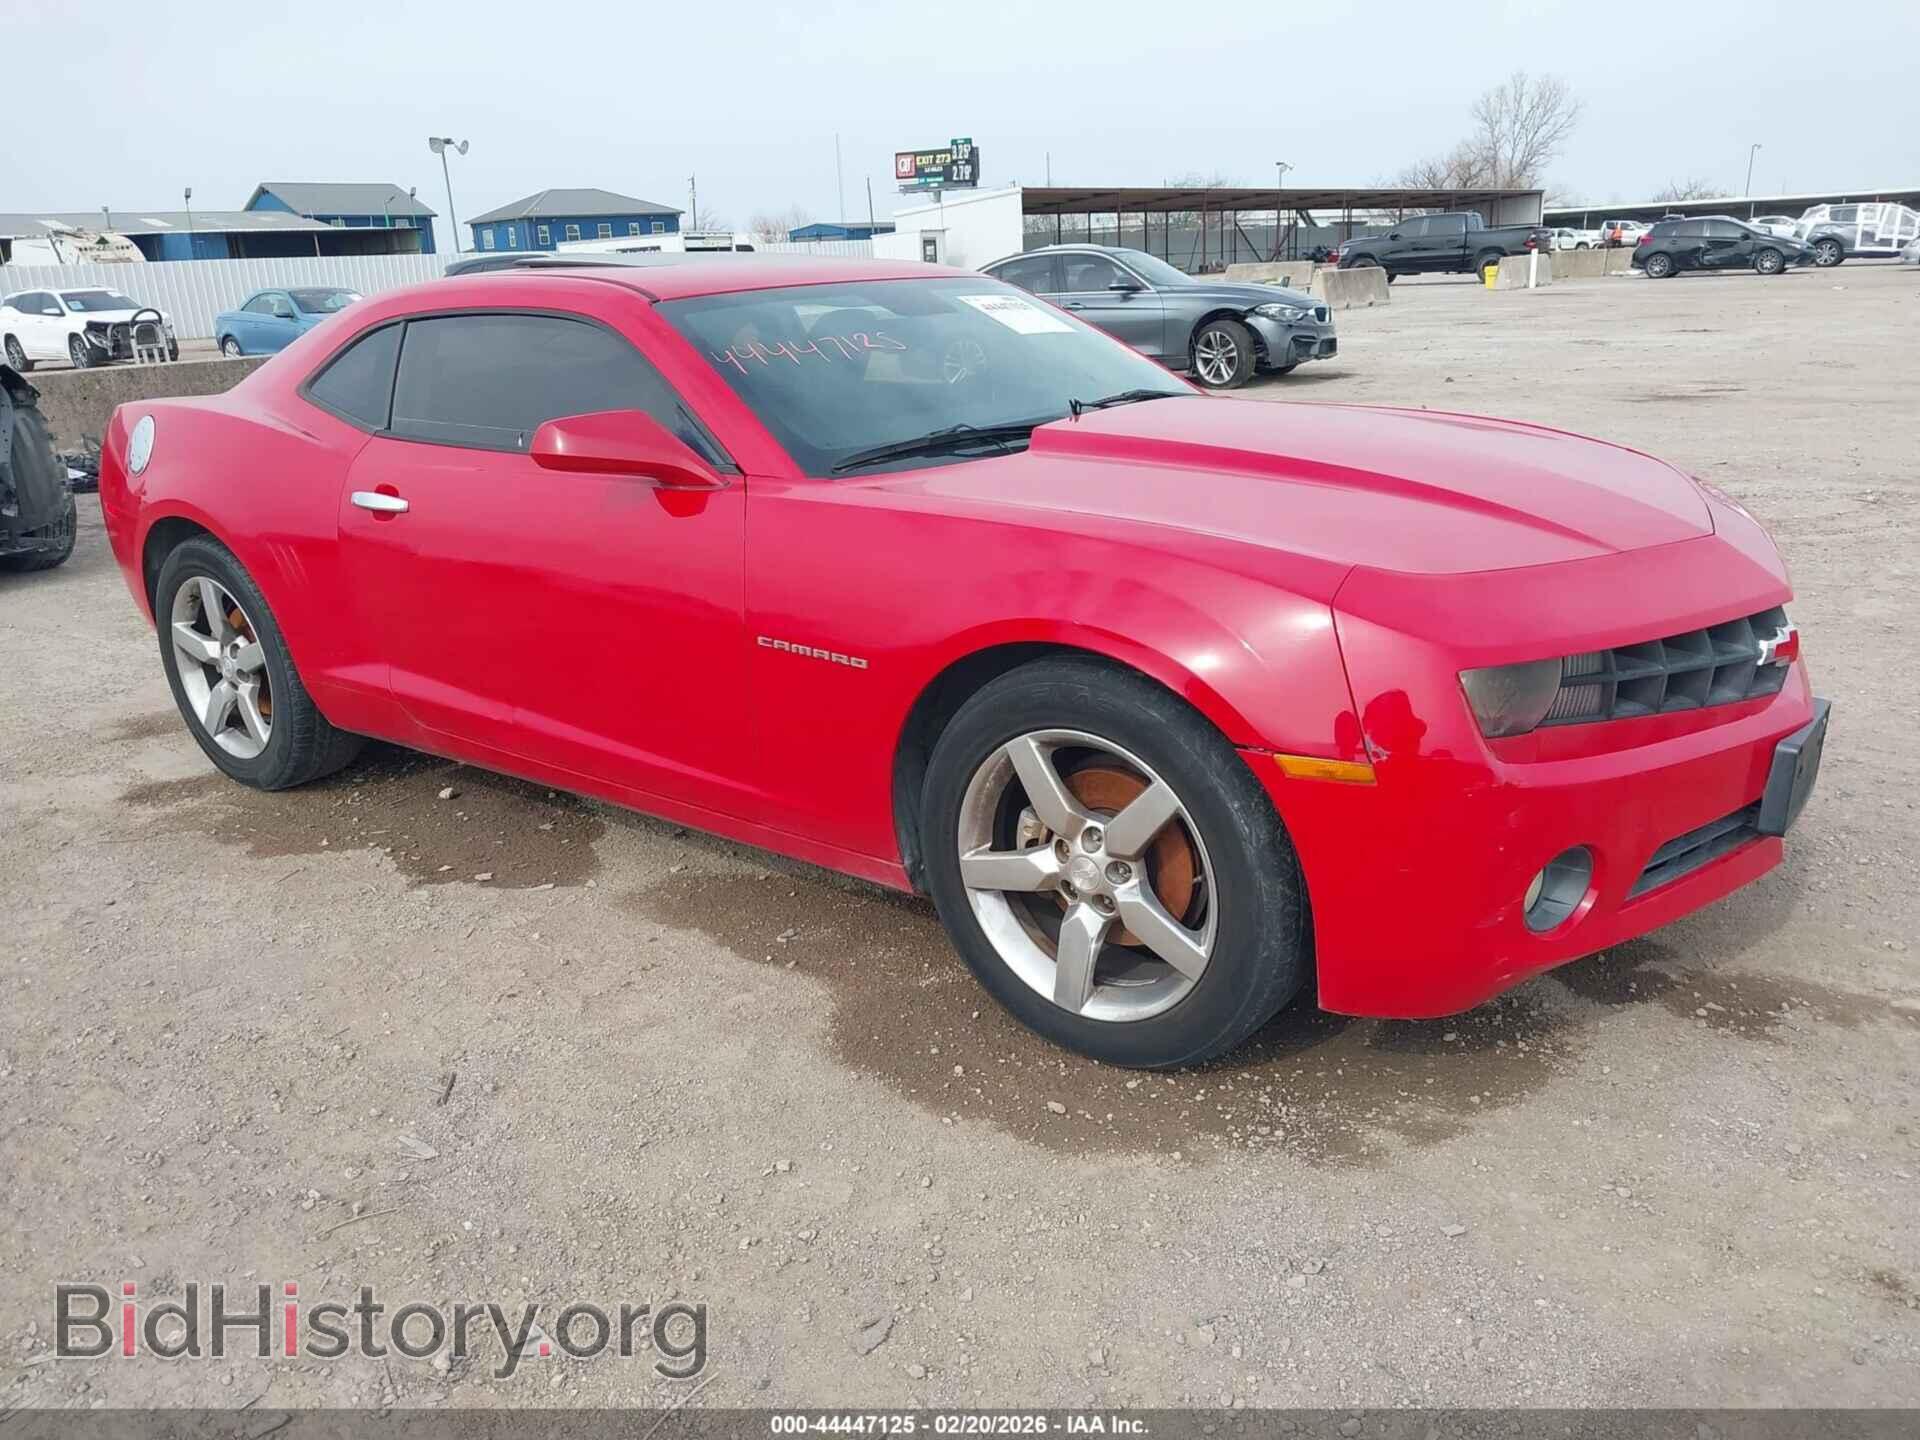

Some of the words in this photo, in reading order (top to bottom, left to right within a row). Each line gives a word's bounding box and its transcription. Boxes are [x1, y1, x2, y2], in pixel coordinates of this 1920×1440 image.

[899, 159, 911, 172] QT
[917, 156, 934, 165] EXIT
[757, 635, 868, 669] CAMARO
